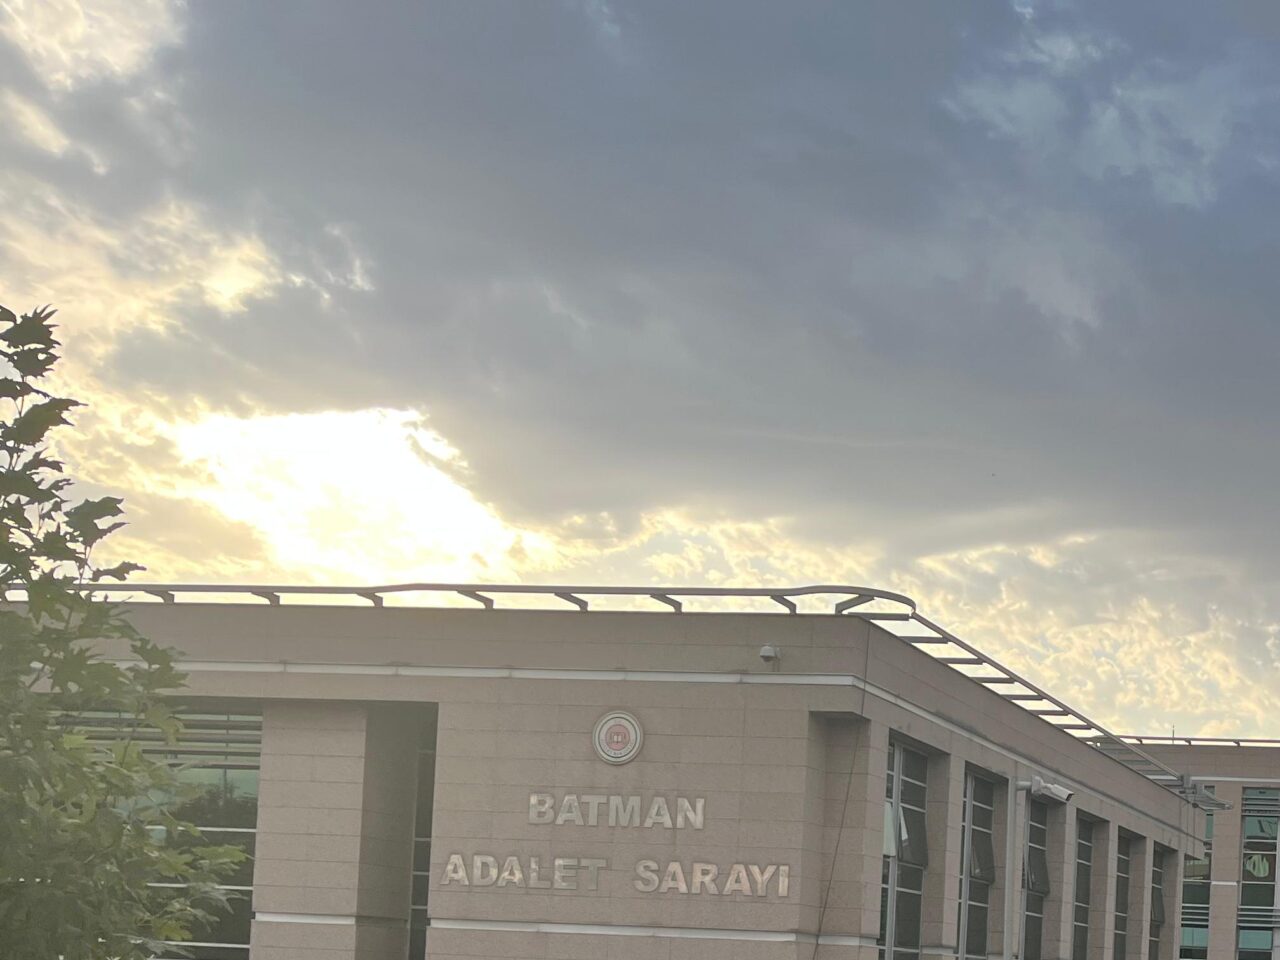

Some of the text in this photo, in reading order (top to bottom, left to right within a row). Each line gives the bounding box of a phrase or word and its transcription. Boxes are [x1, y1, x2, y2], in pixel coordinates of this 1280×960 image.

[528, 792, 705, 830] BATMAN
[440, 853, 791, 897] ADALET SARAYI
